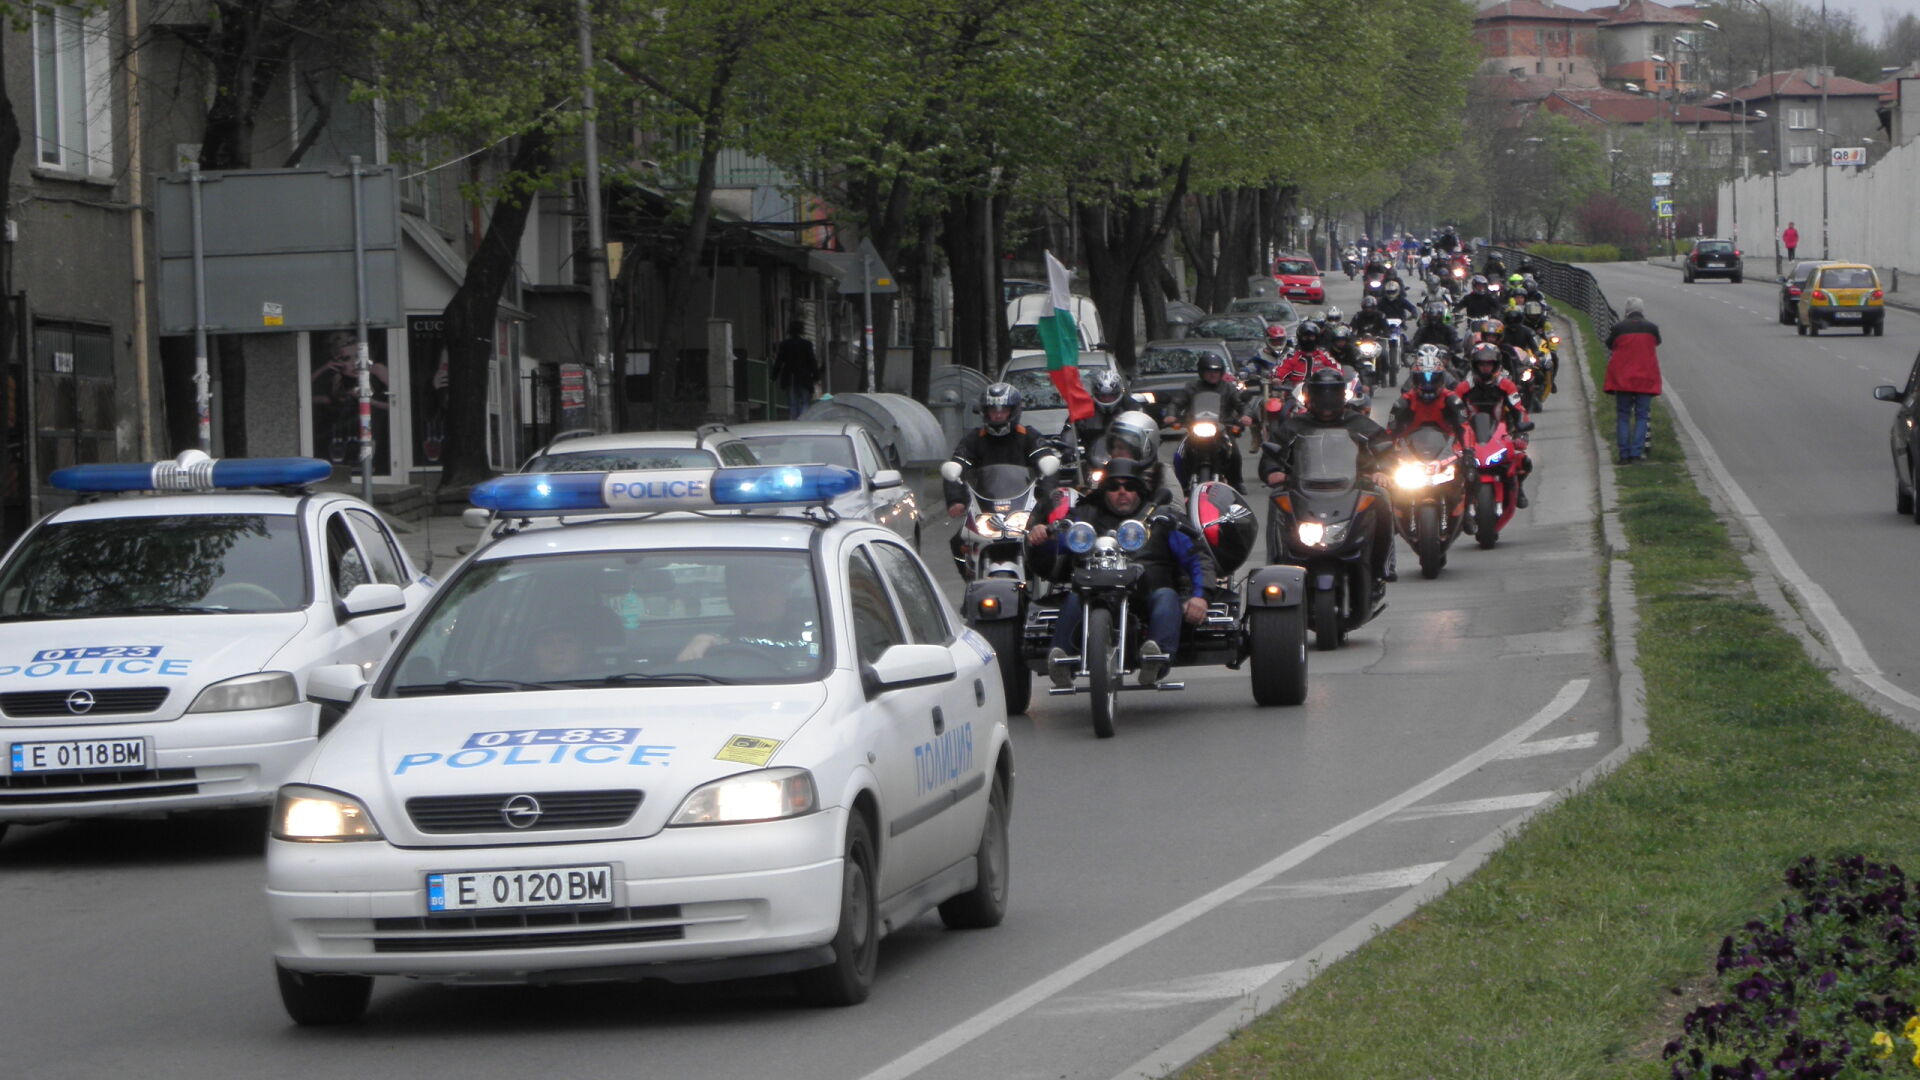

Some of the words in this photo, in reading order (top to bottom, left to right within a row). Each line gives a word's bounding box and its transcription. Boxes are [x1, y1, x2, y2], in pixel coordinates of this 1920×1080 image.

[1833, 151, 1849, 160] Q8
[611, 480, 704, 499] POLICE
[42, 646, 151, 660] 01-23
[475, 728, 627, 746] 01-83
[393, 745, 677, 775] POLICE
[914, 721, 974, 797] ПОЛИЦИЯ
